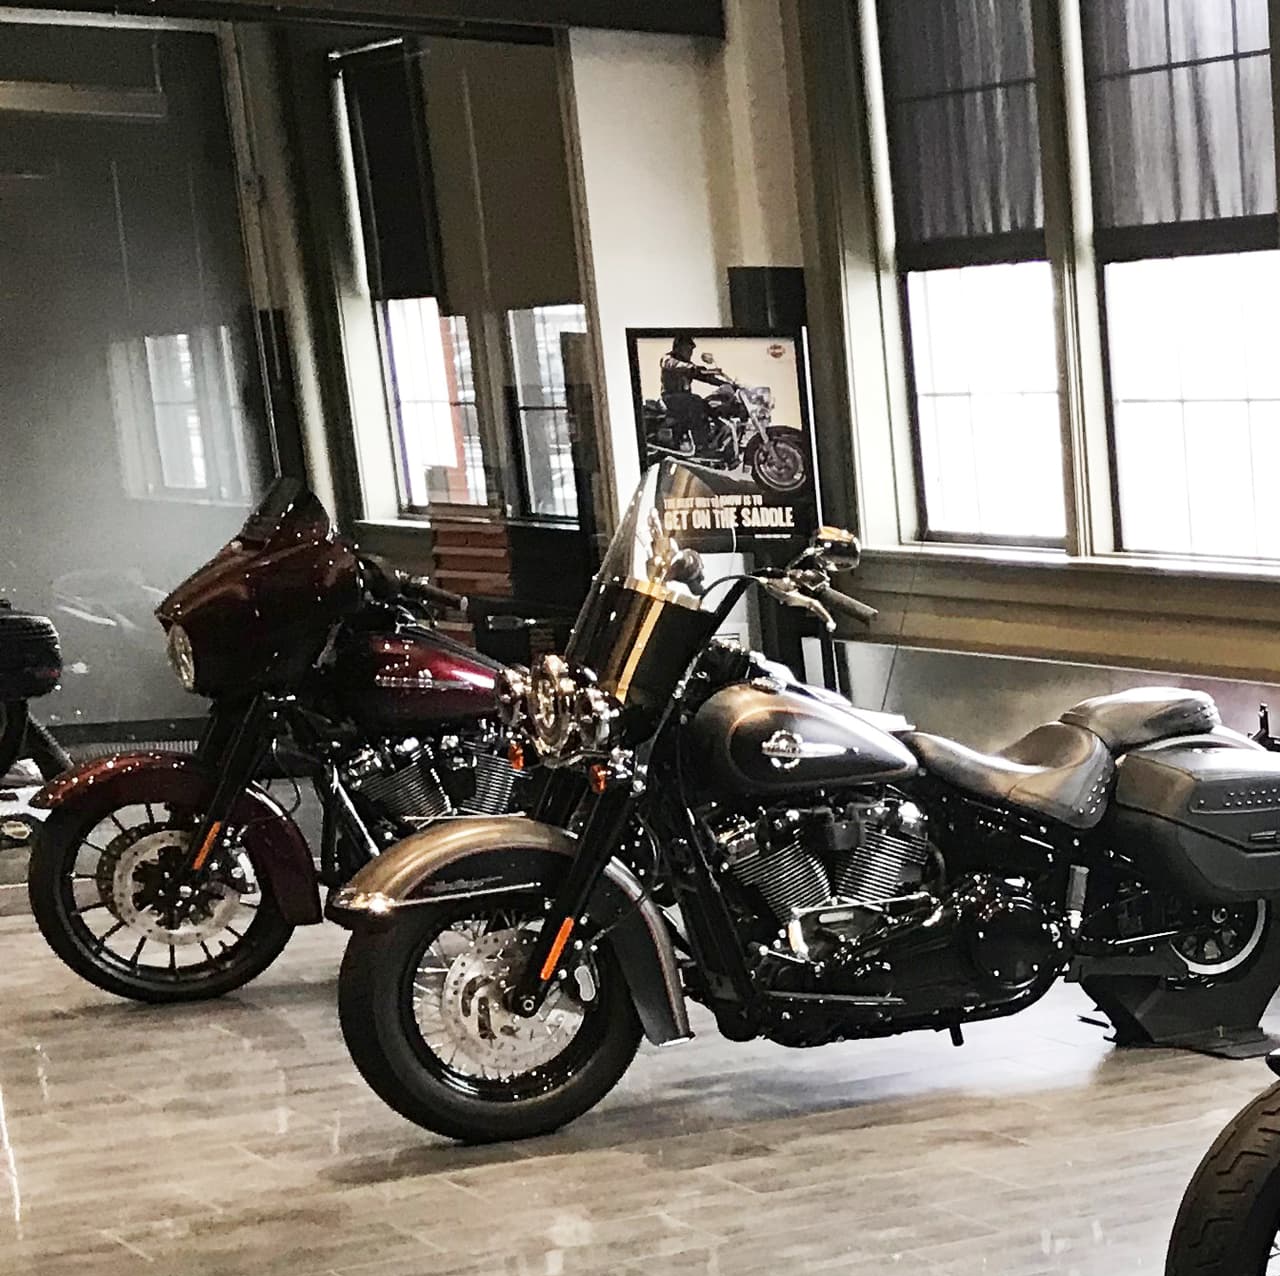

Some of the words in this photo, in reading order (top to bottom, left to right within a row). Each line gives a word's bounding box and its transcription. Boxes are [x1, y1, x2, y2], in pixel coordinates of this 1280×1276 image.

[664, 510, 688, 530] GET
[691, 508, 711, 529] ON
[712, 507, 739, 529] THE
[741, 506, 795, 527] SADDLE
